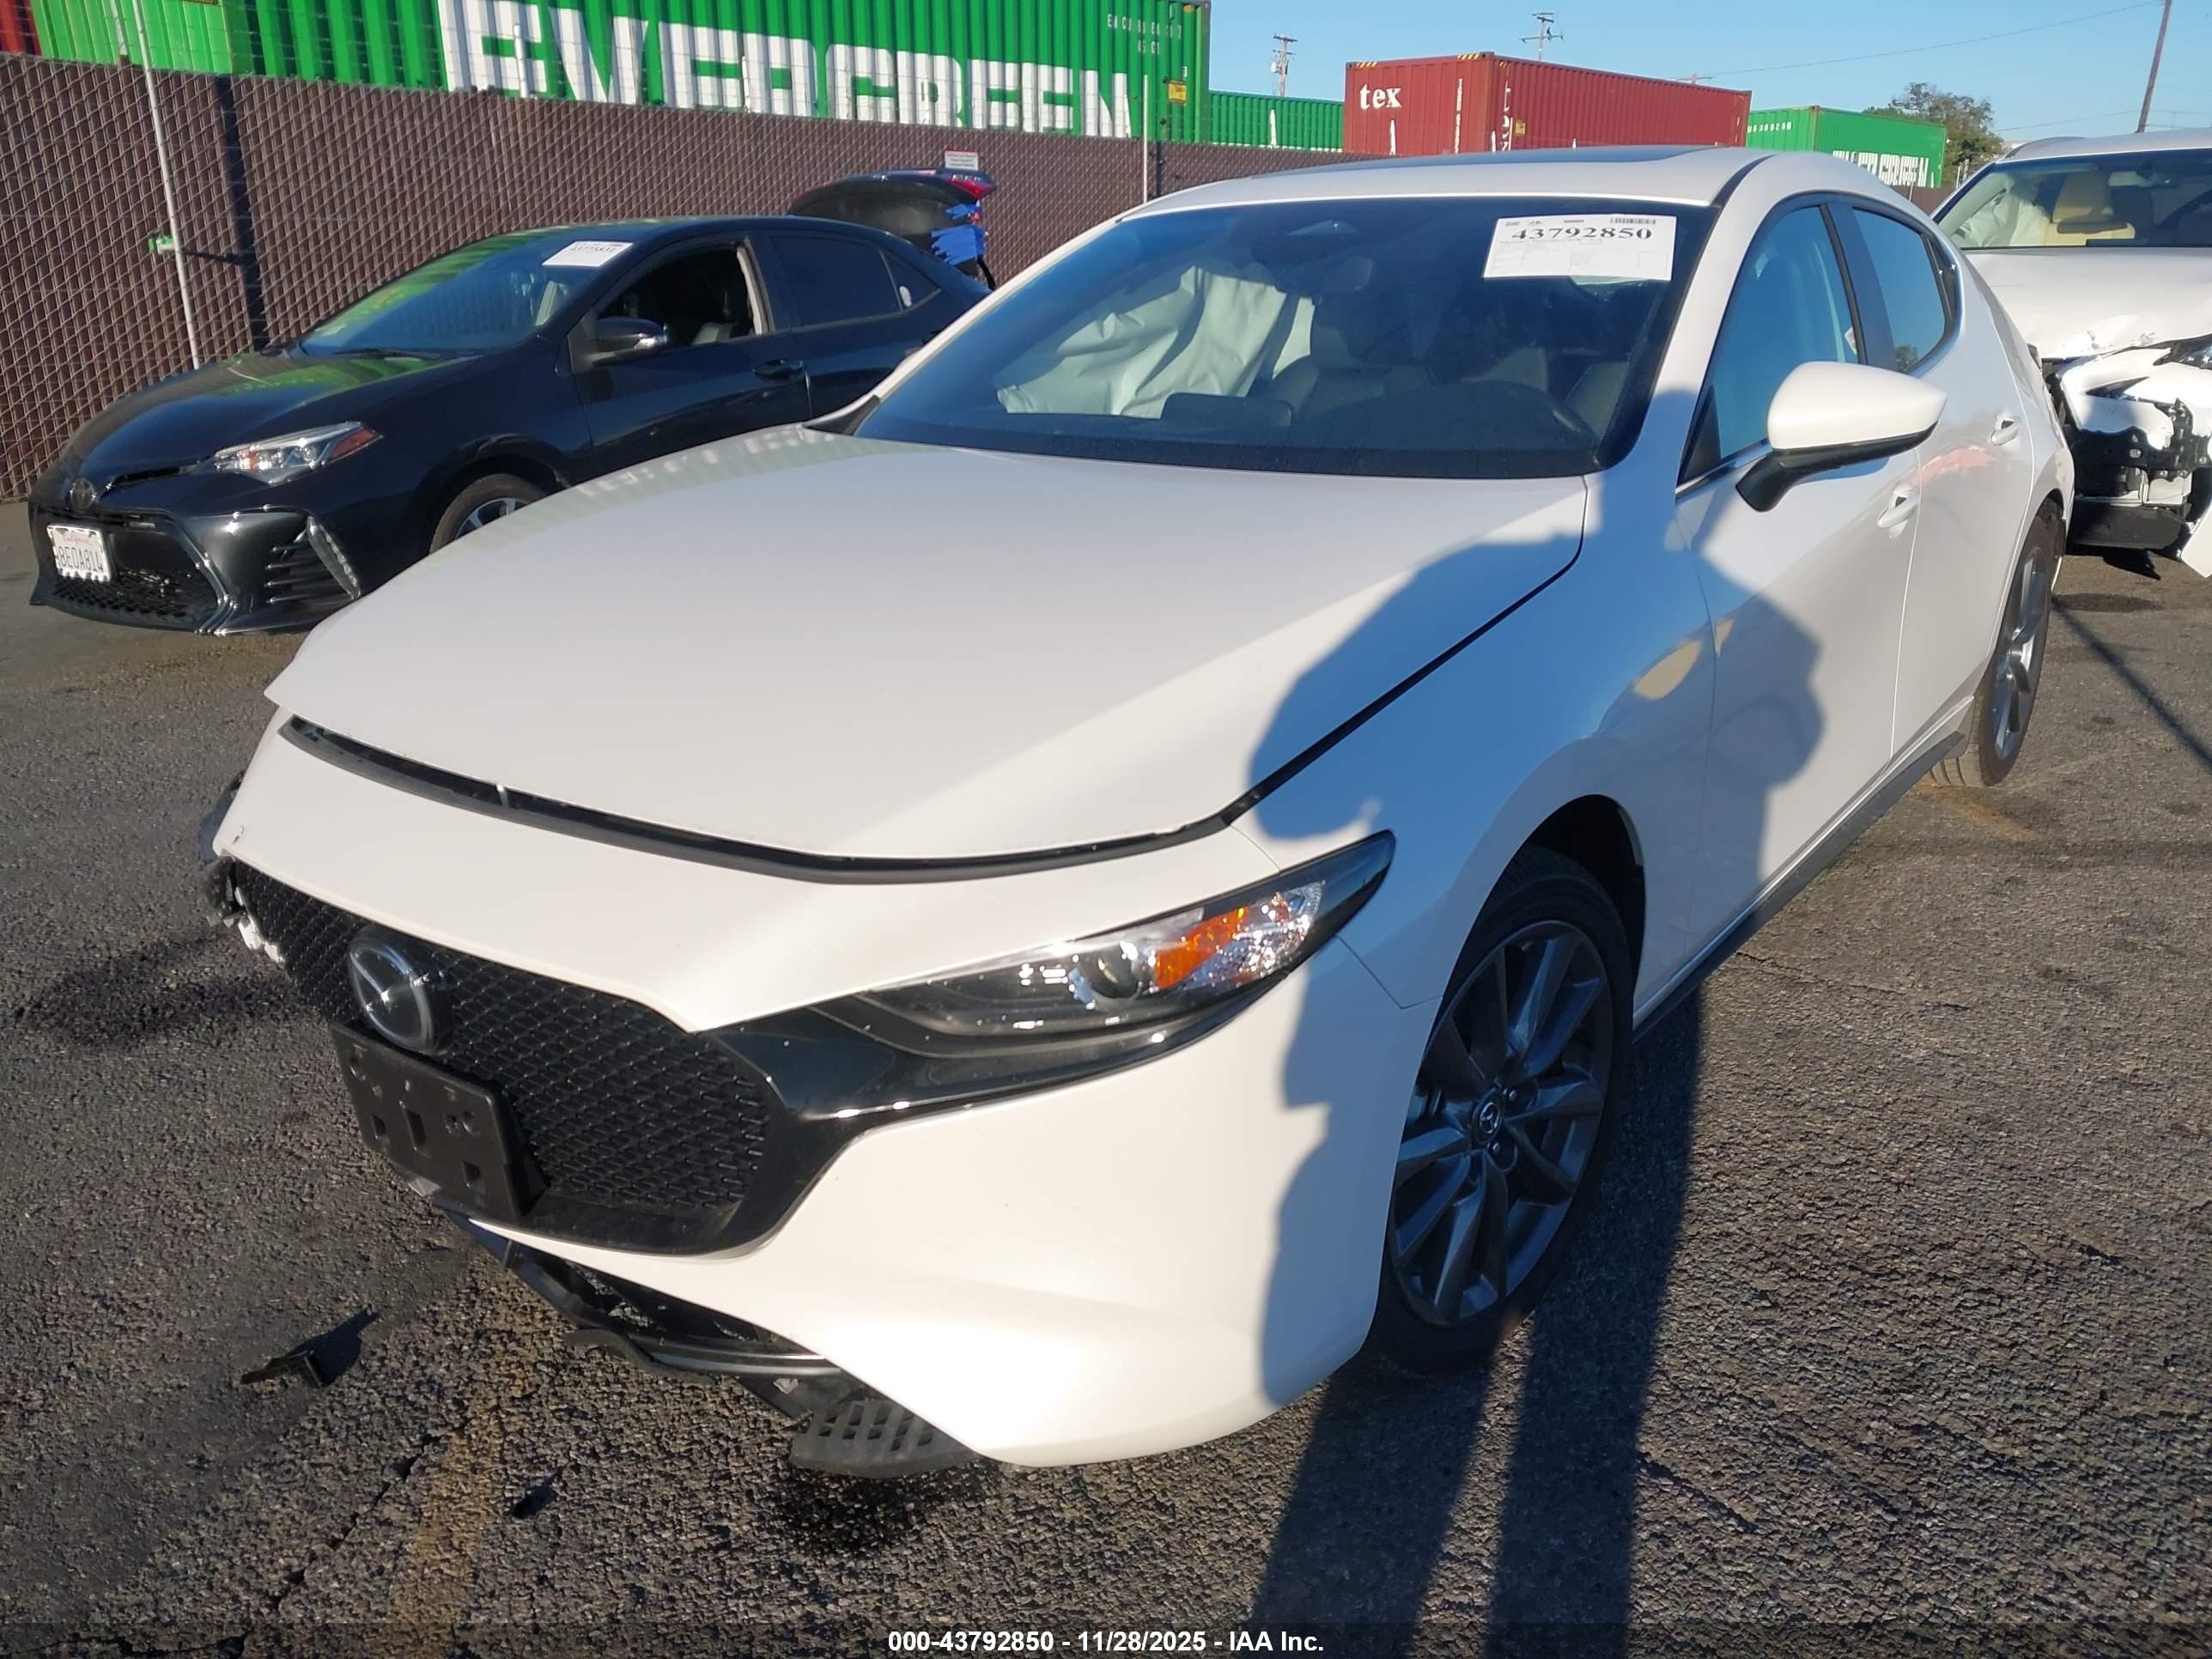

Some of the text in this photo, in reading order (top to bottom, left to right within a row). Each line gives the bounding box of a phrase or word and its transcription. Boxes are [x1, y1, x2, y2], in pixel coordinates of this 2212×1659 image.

[438, 0, 1132, 138] EVERGREEN
[1359, 83, 1402, 110] tex
[1832, 150, 1929, 187] RGREEN
[1511, 227, 1652, 240] 43792850
